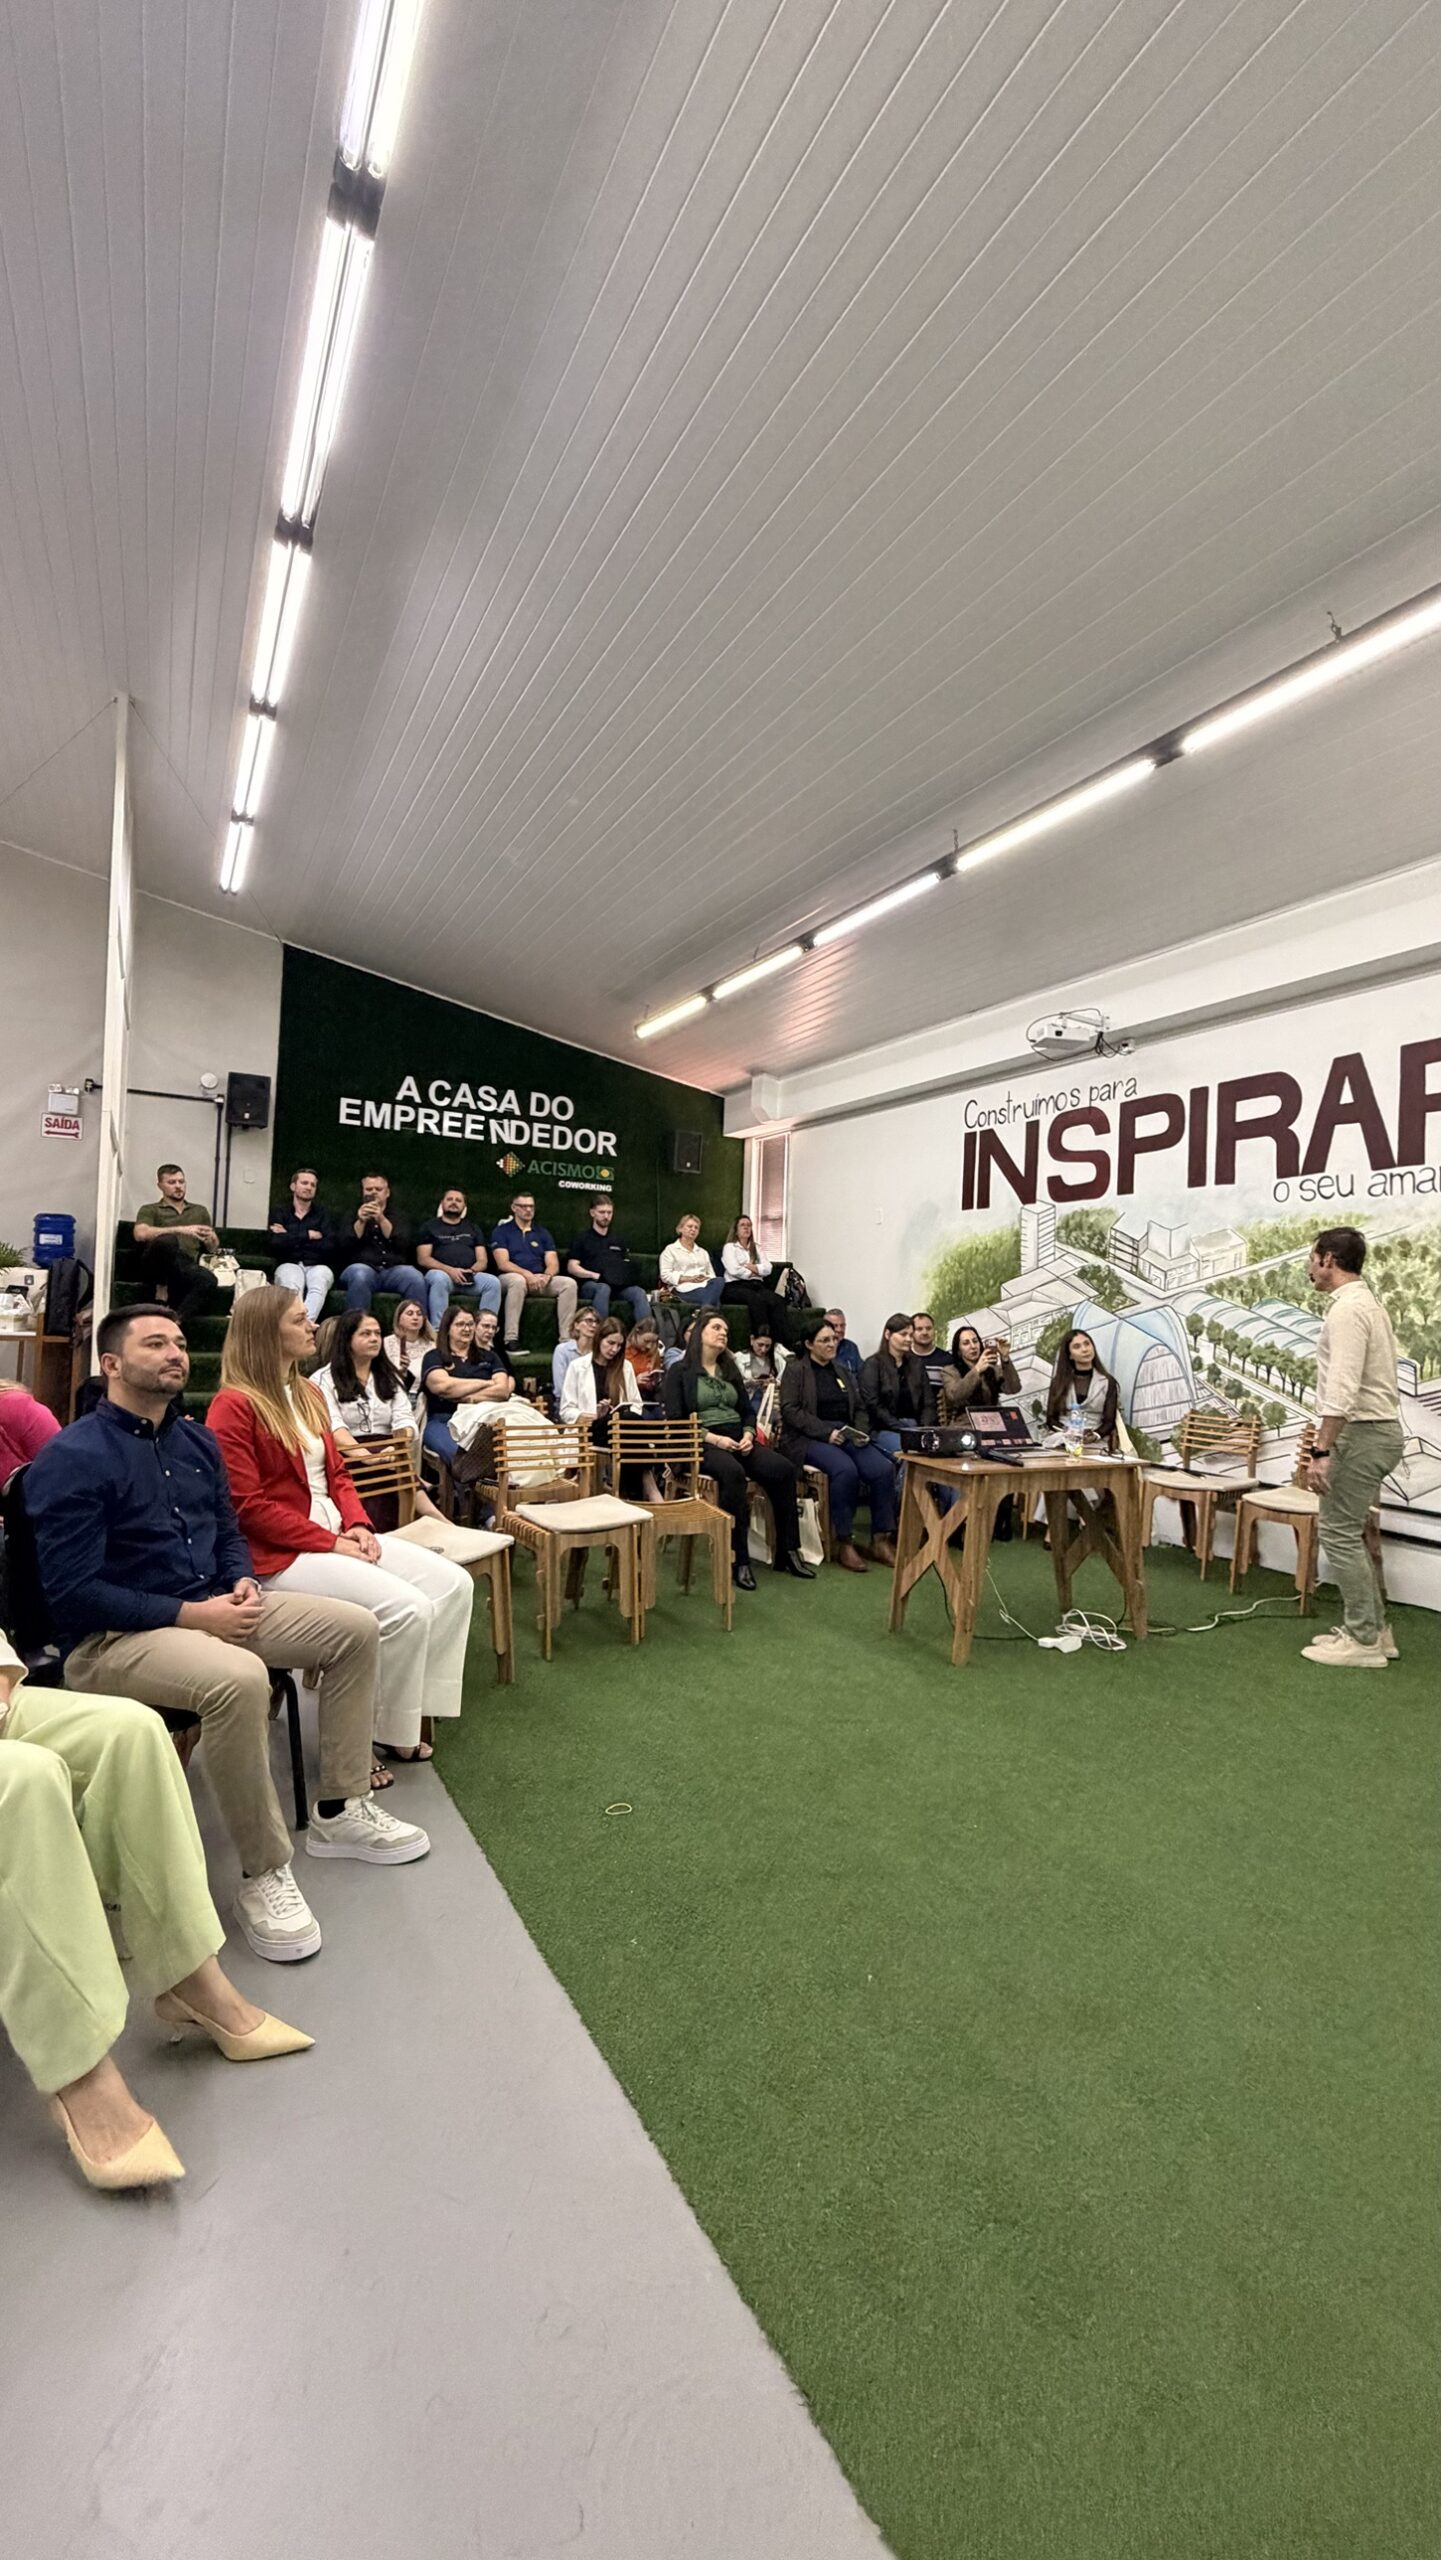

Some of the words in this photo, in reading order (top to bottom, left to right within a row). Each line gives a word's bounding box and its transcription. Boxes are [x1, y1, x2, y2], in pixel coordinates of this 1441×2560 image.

[395, 1075, 422, 1104] A
[428, 1079, 522, 1116] CASA
[529, 1091, 575, 1121] DO
[1089, 1076, 1138, 1114] para
[44, 1116, 81, 1131] SAÍDA
[338, 1096, 618, 1157] EMPREENDEDOR
[526, 1159, 595, 1180] ACISMO
[558, 1180, 613, 1193] COWORKING
[1273, 1181, 1290, 1203] o
[1298, 1173, 1356, 1202] seu
[1367, 1166, 1441, 1198] ama
